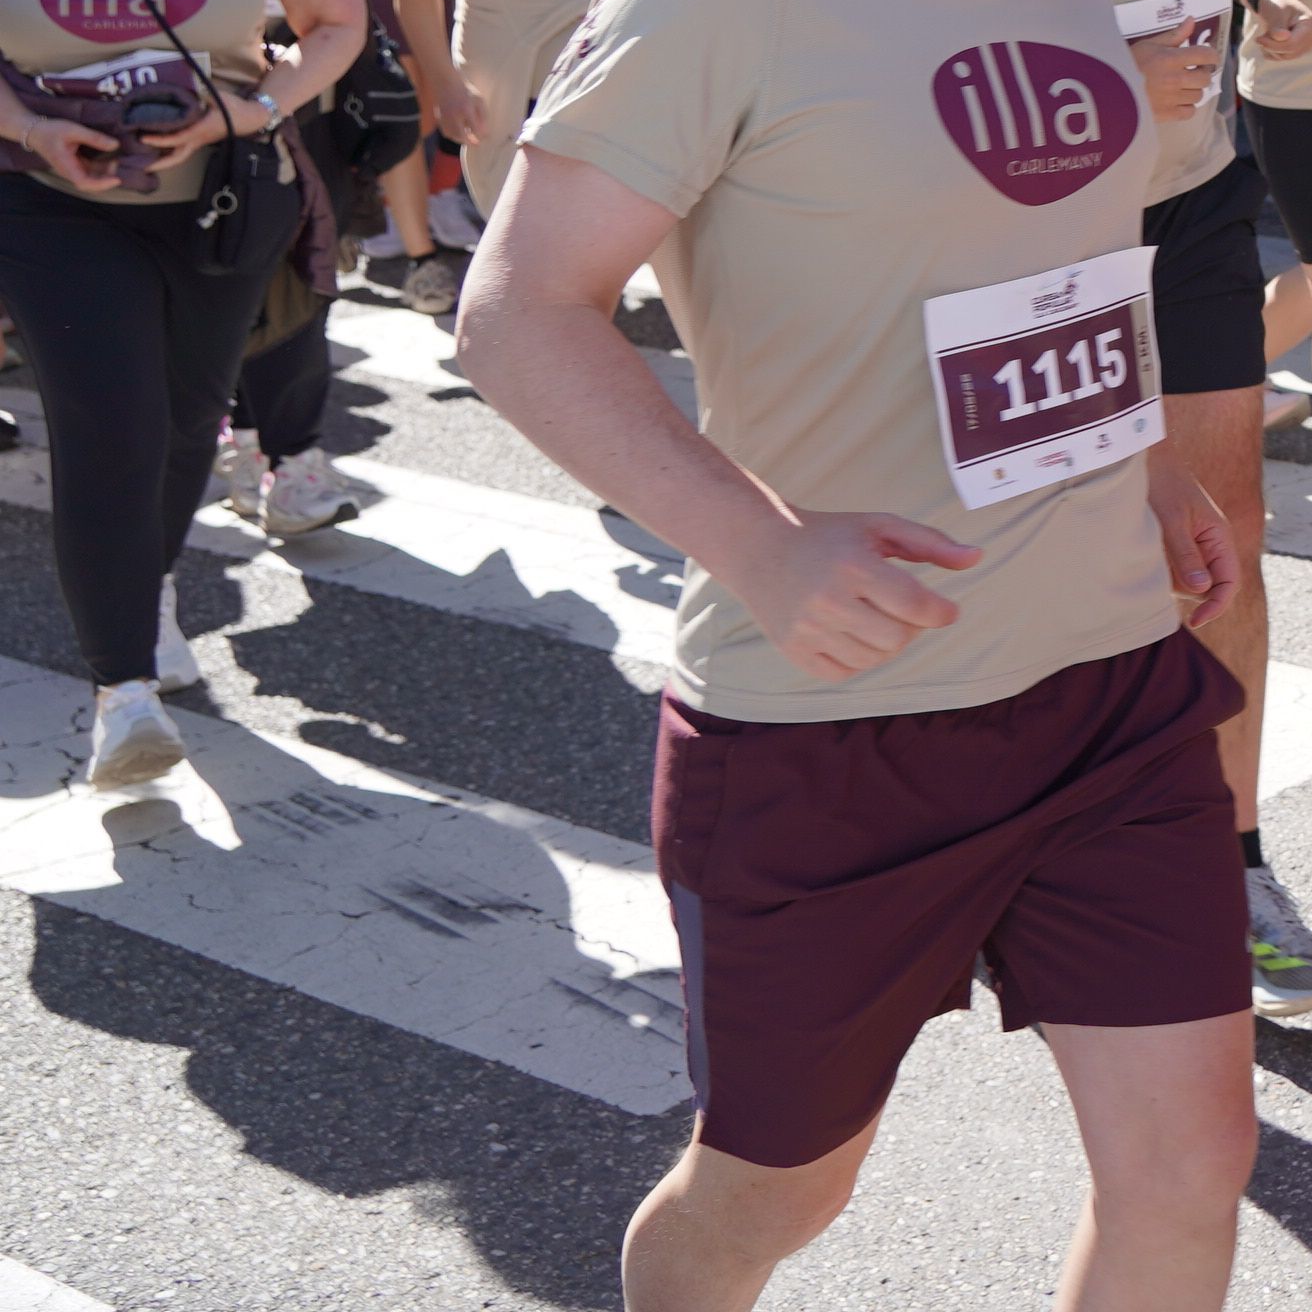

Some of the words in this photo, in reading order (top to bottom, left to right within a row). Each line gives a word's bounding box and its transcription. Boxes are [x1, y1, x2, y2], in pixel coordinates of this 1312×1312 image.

[952, 41, 1102, 153] illa
[1006, 151, 1104, 177] CARLEMANY
[993, 328, 1127, 422] 1115
